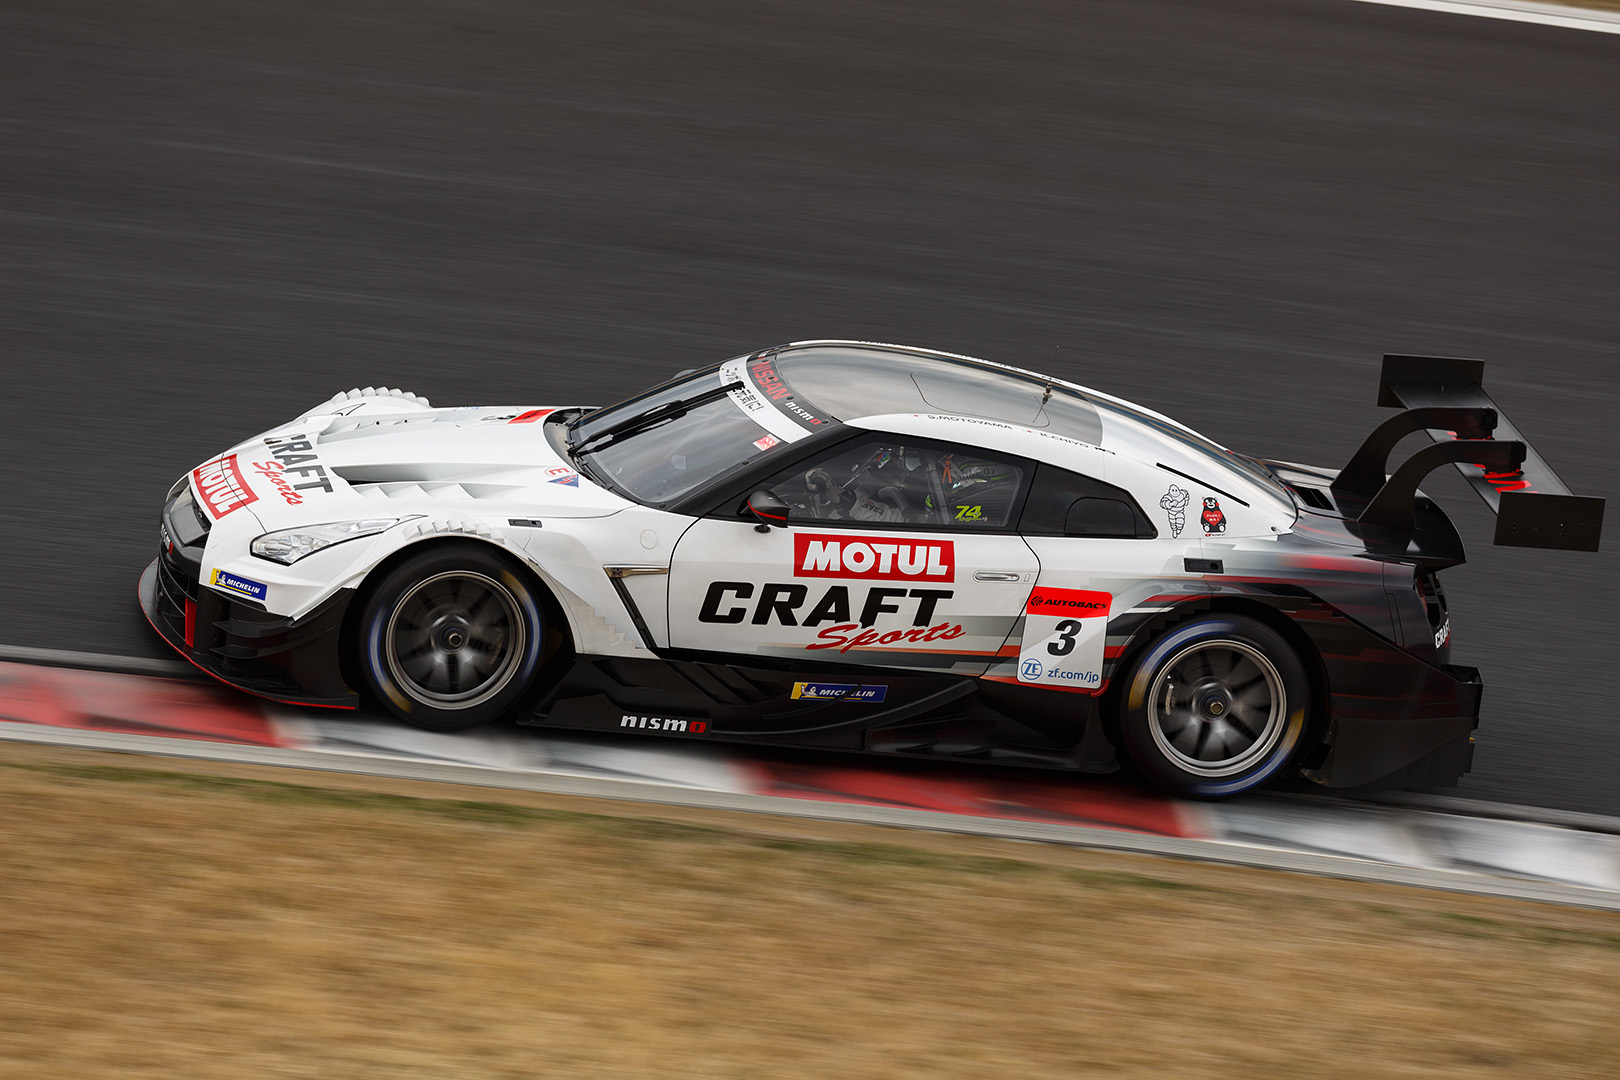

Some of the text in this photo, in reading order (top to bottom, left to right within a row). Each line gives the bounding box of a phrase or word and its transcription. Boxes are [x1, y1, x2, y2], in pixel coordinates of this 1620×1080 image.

[752, 361, 790, 401] NISSAN
[785, 401, 822, 425] nismo
[199, 457, 249, 514] MOTUL
[252, 461, 303, 506] Sports
[954, 505, 982, 519] 74
[802, 540, 949, 576] MOTUL
[226, 578, 261, 594] MICHELIN
[698, 581, 955, 629] CRAFT
[1044, 598, 1109, 610] AUTOBACS
[805, 621, 967, 654] Sports
[1047, 619, 1083, 657] 3
[1023, 661, 1041, 677] ZF
[1047, 668, 1099, 684] zf.com/jp
[819, 689, 876, 697] MICLIN
[620, 715, 706, 734] nismo
